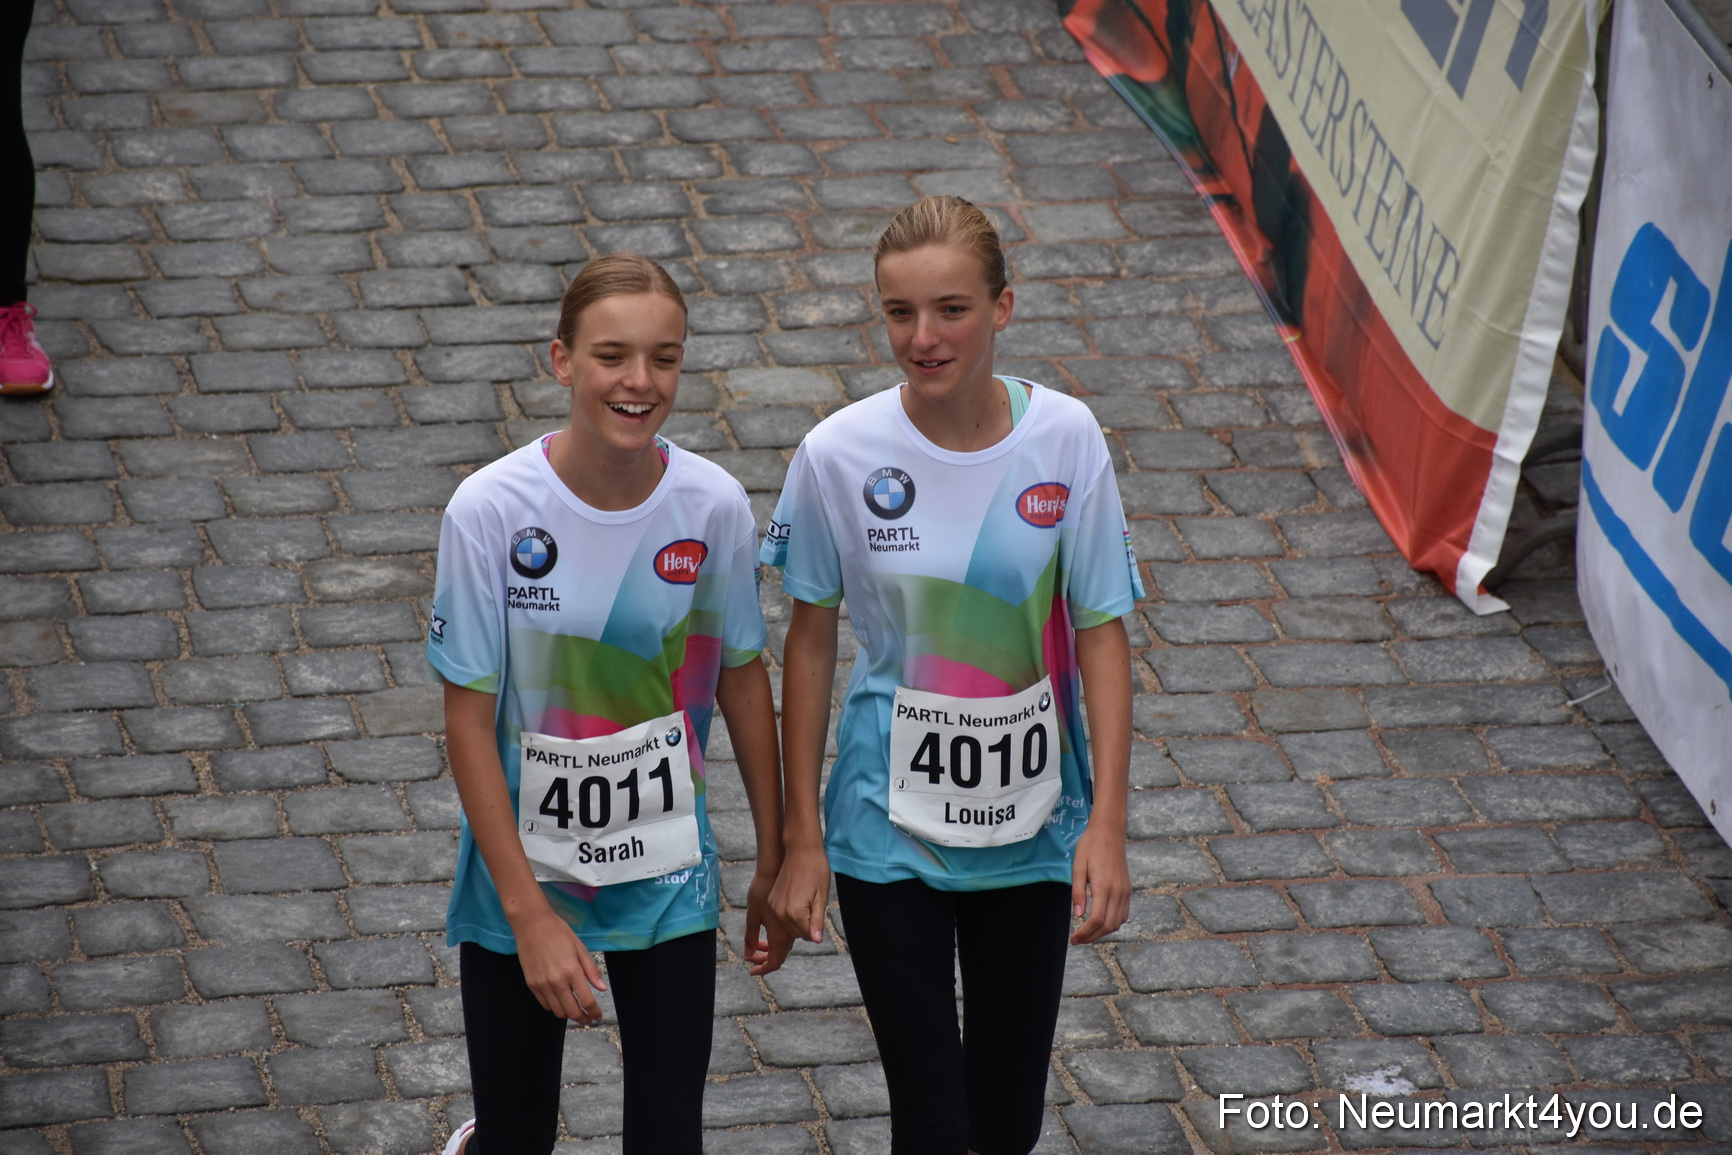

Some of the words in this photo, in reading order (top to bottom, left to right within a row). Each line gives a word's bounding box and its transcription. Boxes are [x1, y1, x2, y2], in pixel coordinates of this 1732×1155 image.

[867, 468, 911, 486] BMW
[511, 528, 553, 546] BMW
[867, 526, 920, 542] PARTL
[869, 541, 921, 552] Neumarkt
[507, 586, 560, 601] PARTL
[507, 600, 560, 612] Neumarkt
[897, 704, 955, 726] PARTL
[959, 704, 1036, 728] Neumarkt
[526, 747, 583, 769] PARTL
[587, 737, 661, 768] Neumarkt
[910, 722, 1048, 789] 4010
[539, 757, 674, 830] 4011
[944, 802, 1016, 826] Louisa
[578, 836, 645, 864] Sarah
